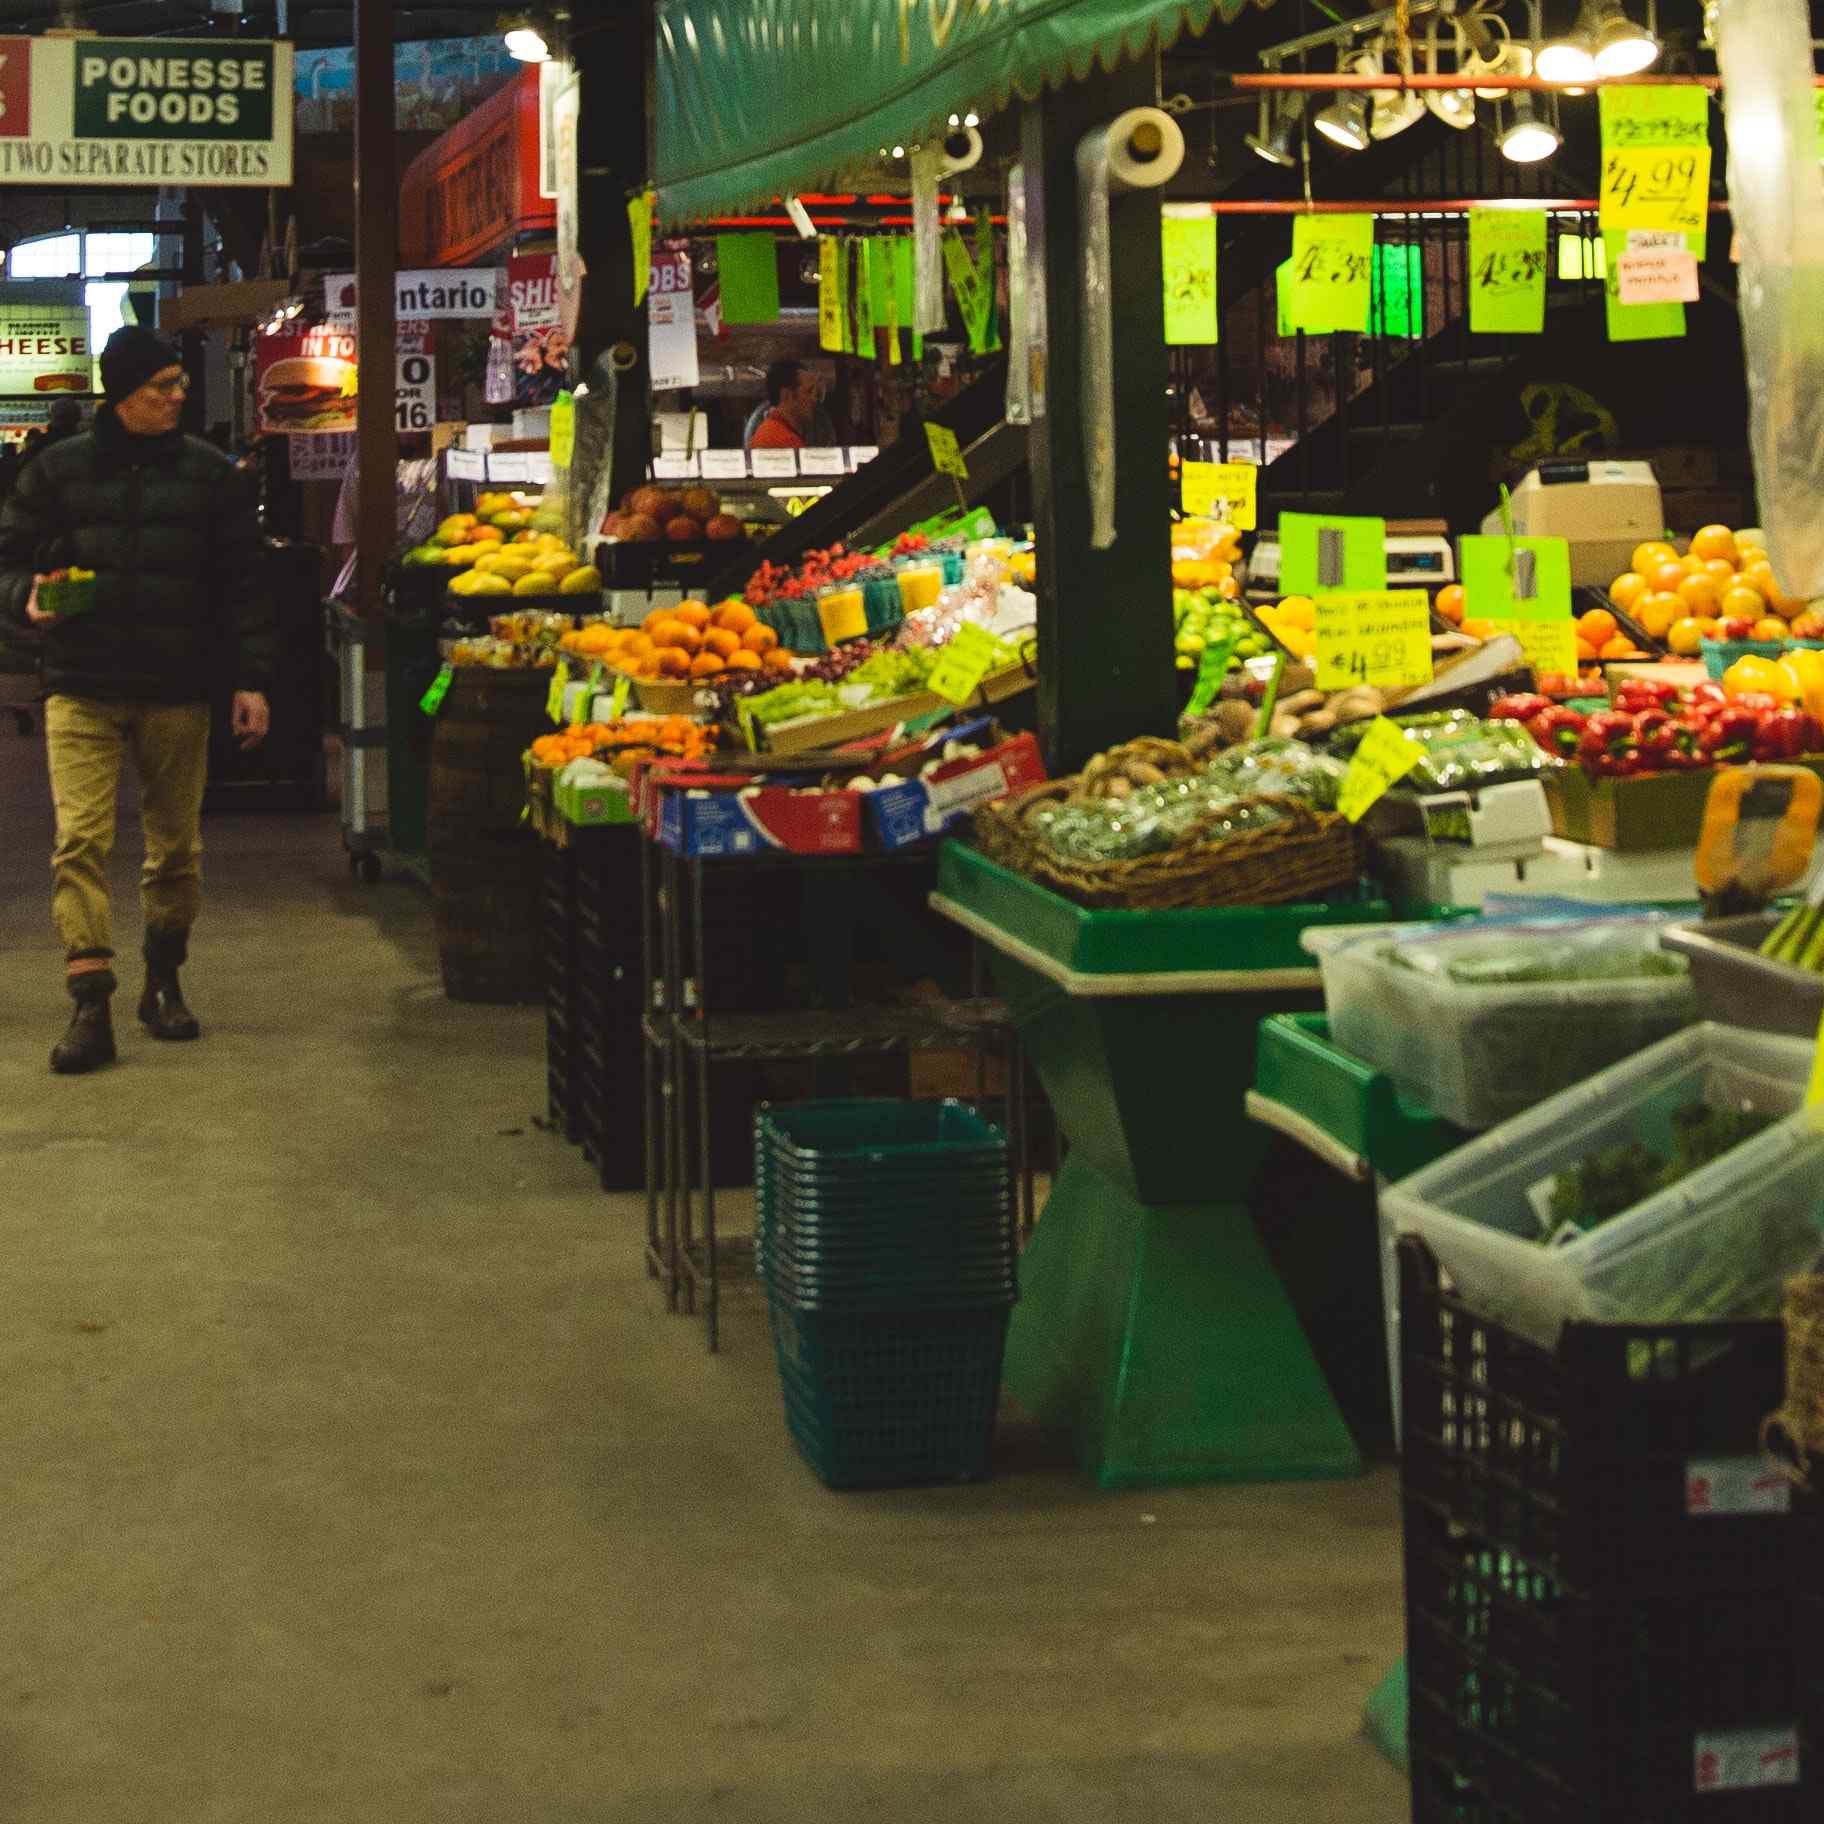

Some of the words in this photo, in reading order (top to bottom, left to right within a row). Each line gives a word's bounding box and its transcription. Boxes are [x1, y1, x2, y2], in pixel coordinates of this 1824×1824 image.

[81, 55, 266, 89] PONESSE
[105, 92, 241, 124] FOODS
[1, 141, 54, 175] TWO
[58, 141, 176, 177] SEPARATE
[178, 144, 269, 178] STORES
[399, 280, 487, 311] ntario
[300, 336, 322, 357] IN
